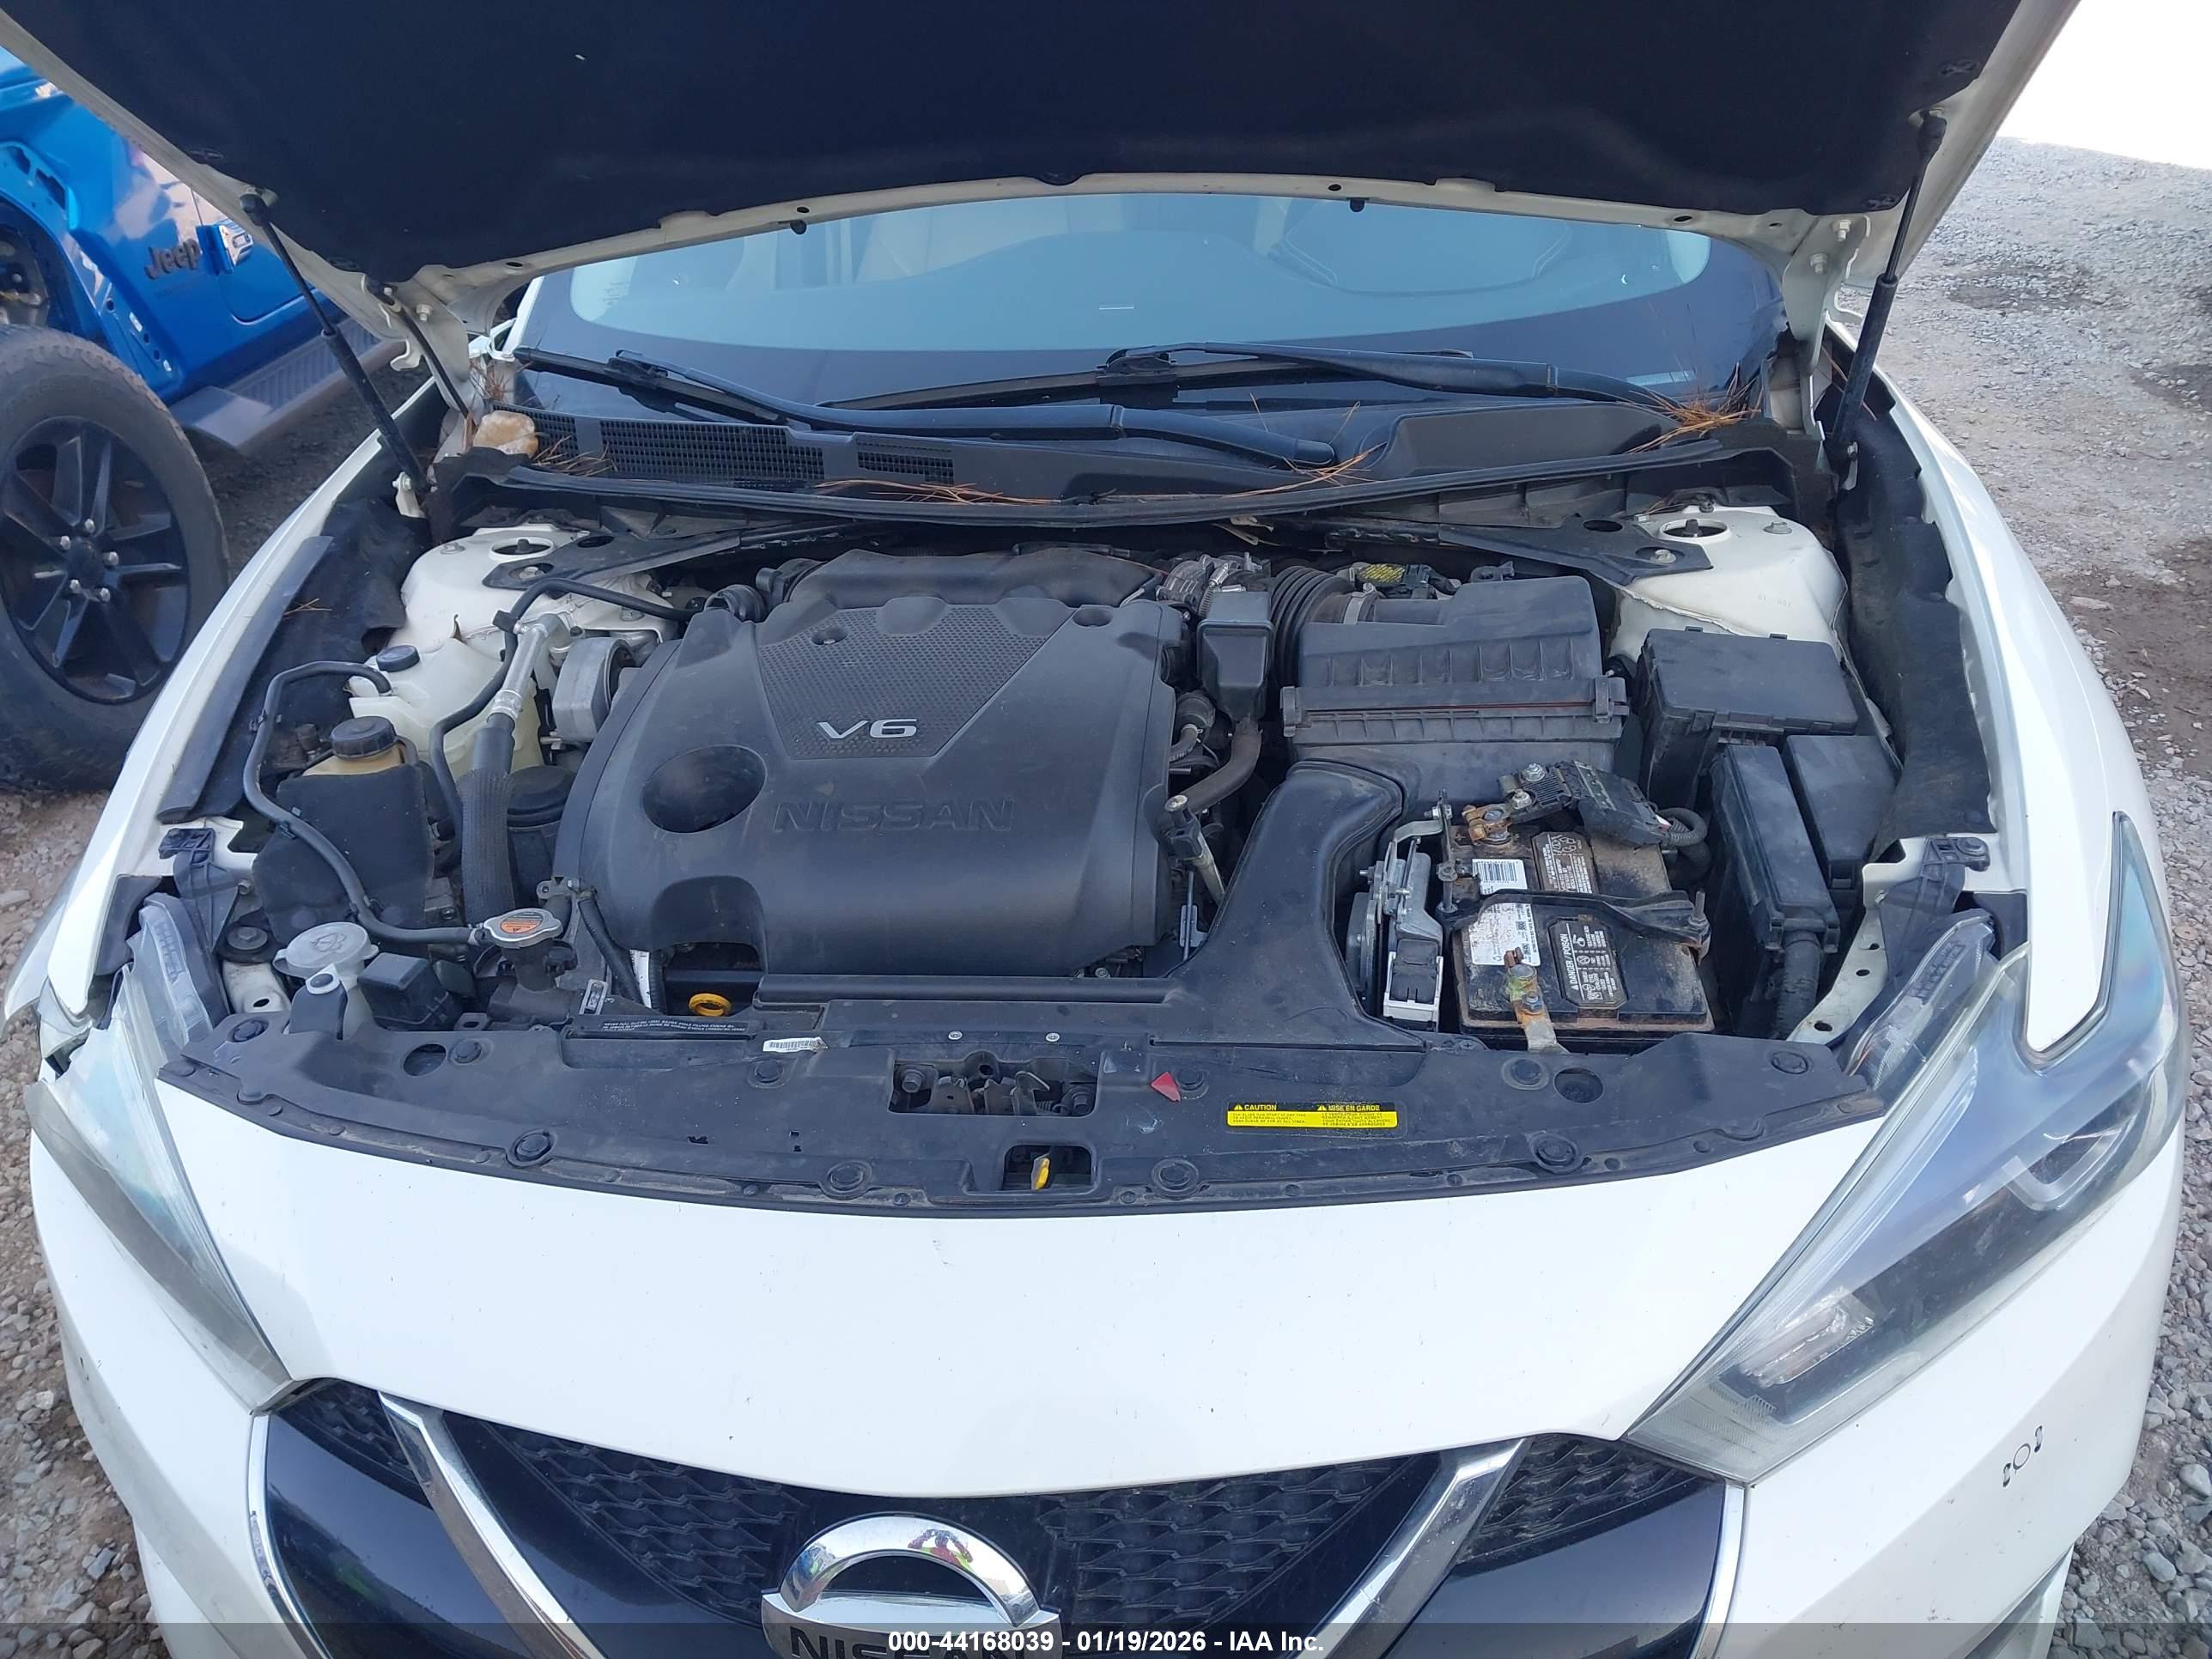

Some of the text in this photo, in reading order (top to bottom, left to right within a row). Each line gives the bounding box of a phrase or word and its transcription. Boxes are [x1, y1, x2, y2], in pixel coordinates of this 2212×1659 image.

[144, 238, 201, 280] Jeep
[817, 718, 918, 739] V6
[773, 797, 1015, 832] NISSAN
[1560, 933, 1571, 955] POISON
[1565, 960, 1578, 984] DANGER
